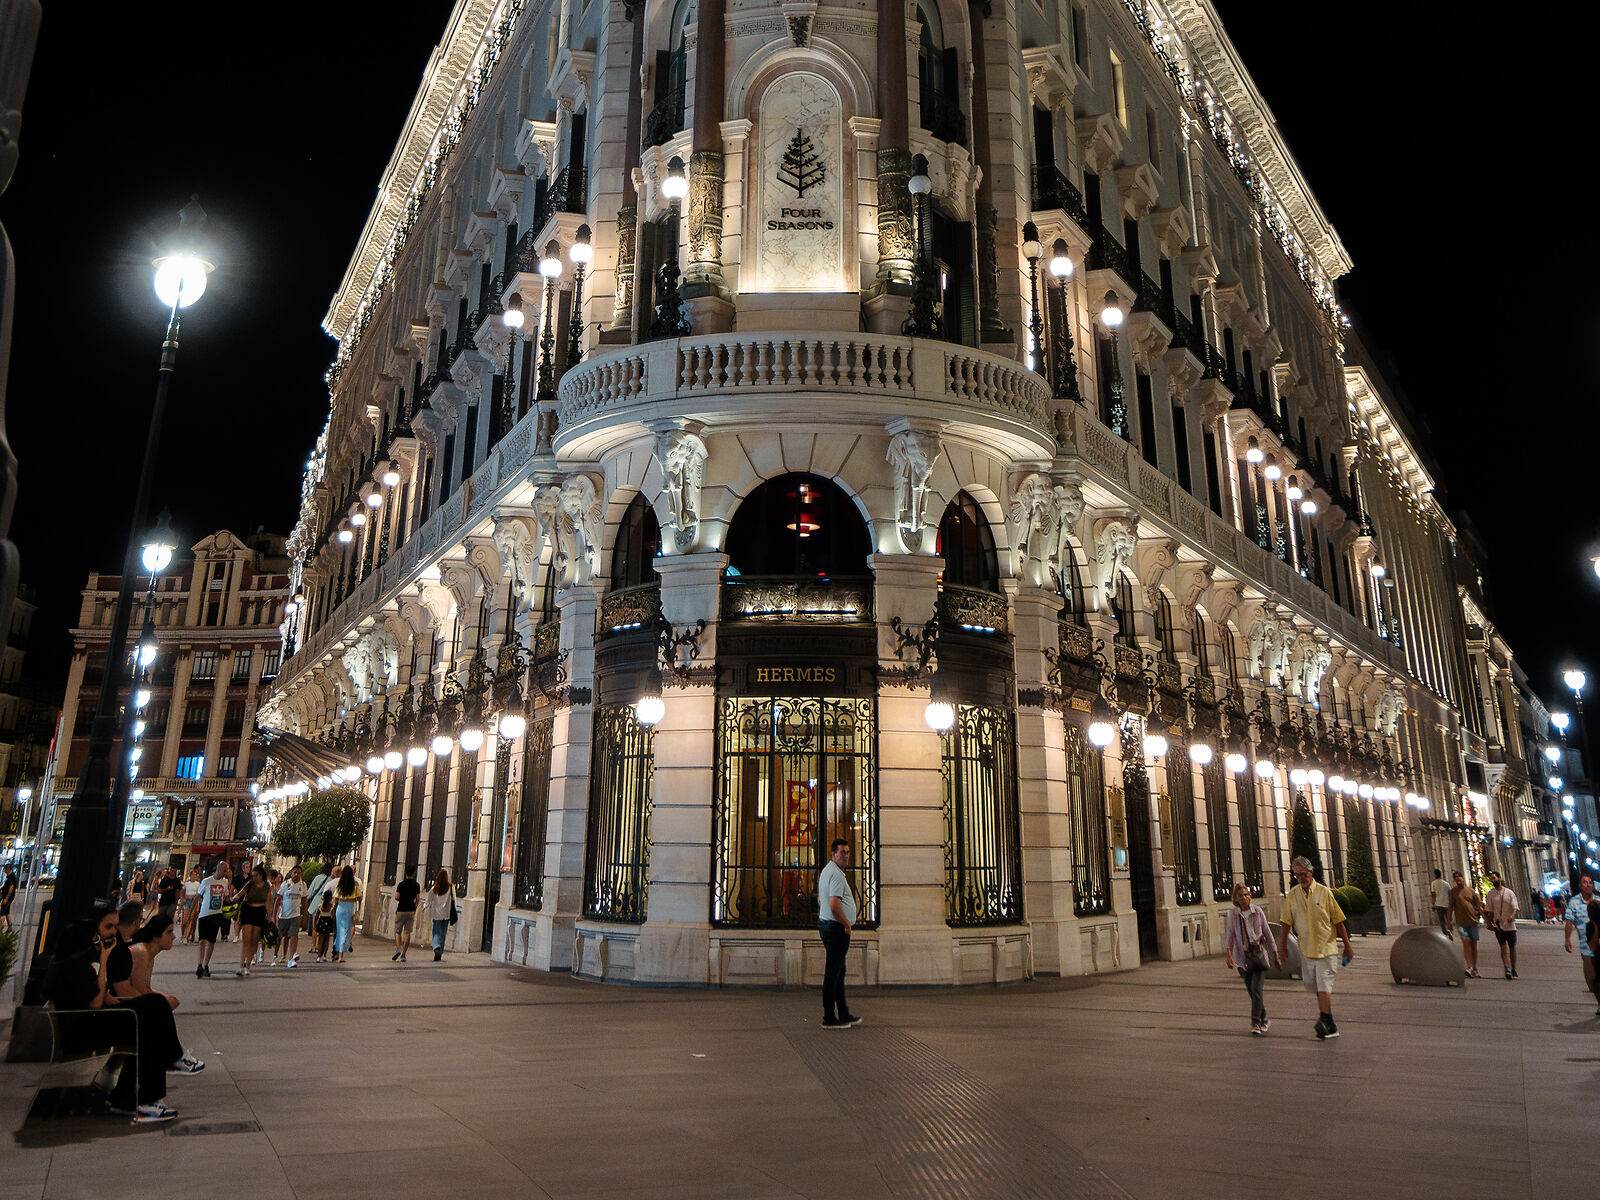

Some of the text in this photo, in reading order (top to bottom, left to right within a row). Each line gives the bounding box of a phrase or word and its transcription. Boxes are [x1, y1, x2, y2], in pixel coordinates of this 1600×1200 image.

[780, 207, 822, 218] FOUR
[767, 220, 834, 231] SEASONS
[757, 665, 836, 682] HERMÈS
